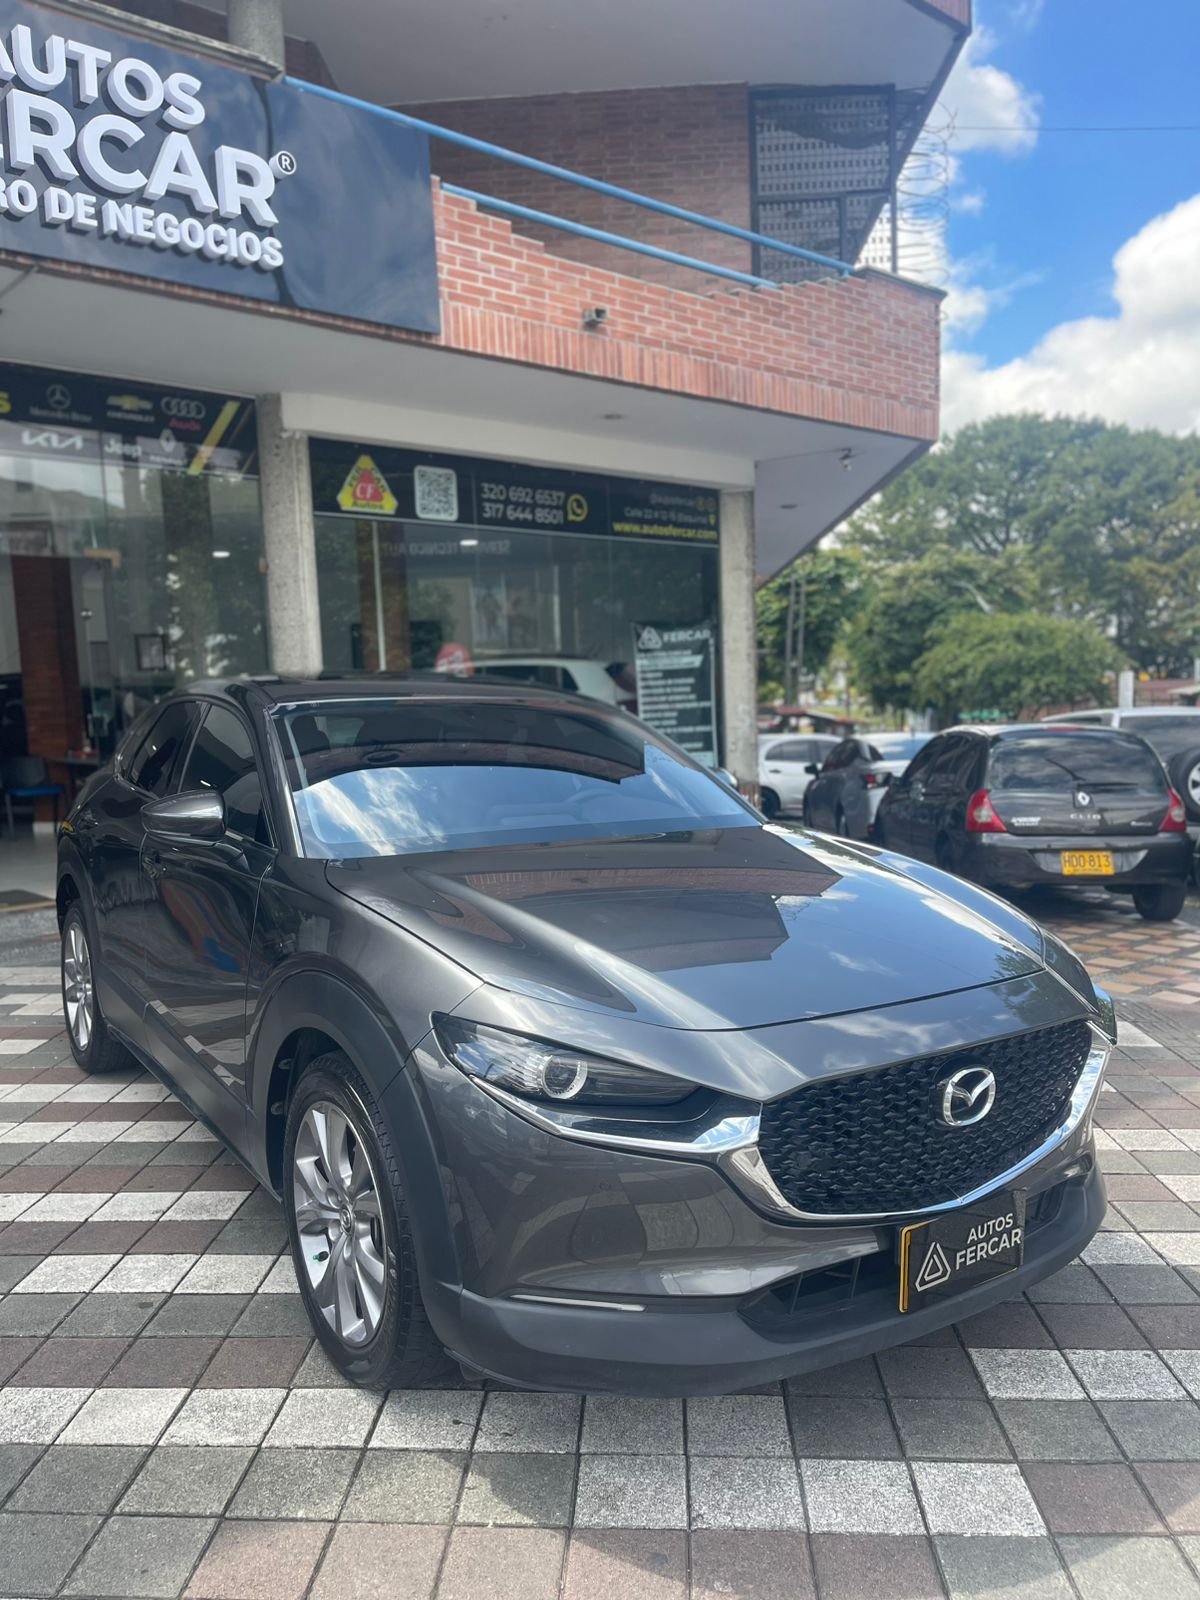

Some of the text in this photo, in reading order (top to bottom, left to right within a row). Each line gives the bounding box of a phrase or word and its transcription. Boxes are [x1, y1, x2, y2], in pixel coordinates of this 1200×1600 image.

[0, 89, 279, 228] RCAR
[44, 186, 98, 231] DE
[102, 199, 284, 271] NEGOCIOS
[103, 438, 142, 459] Jeep
[481, 483, 507, 501] 320
[508, 486, 534, 504] 692
[481, 502, 564, 525] 317 644 8501
[967, 1213, 1013, 1244] AUTOS
[955, 1228, 1022, 1270] FERCAR
